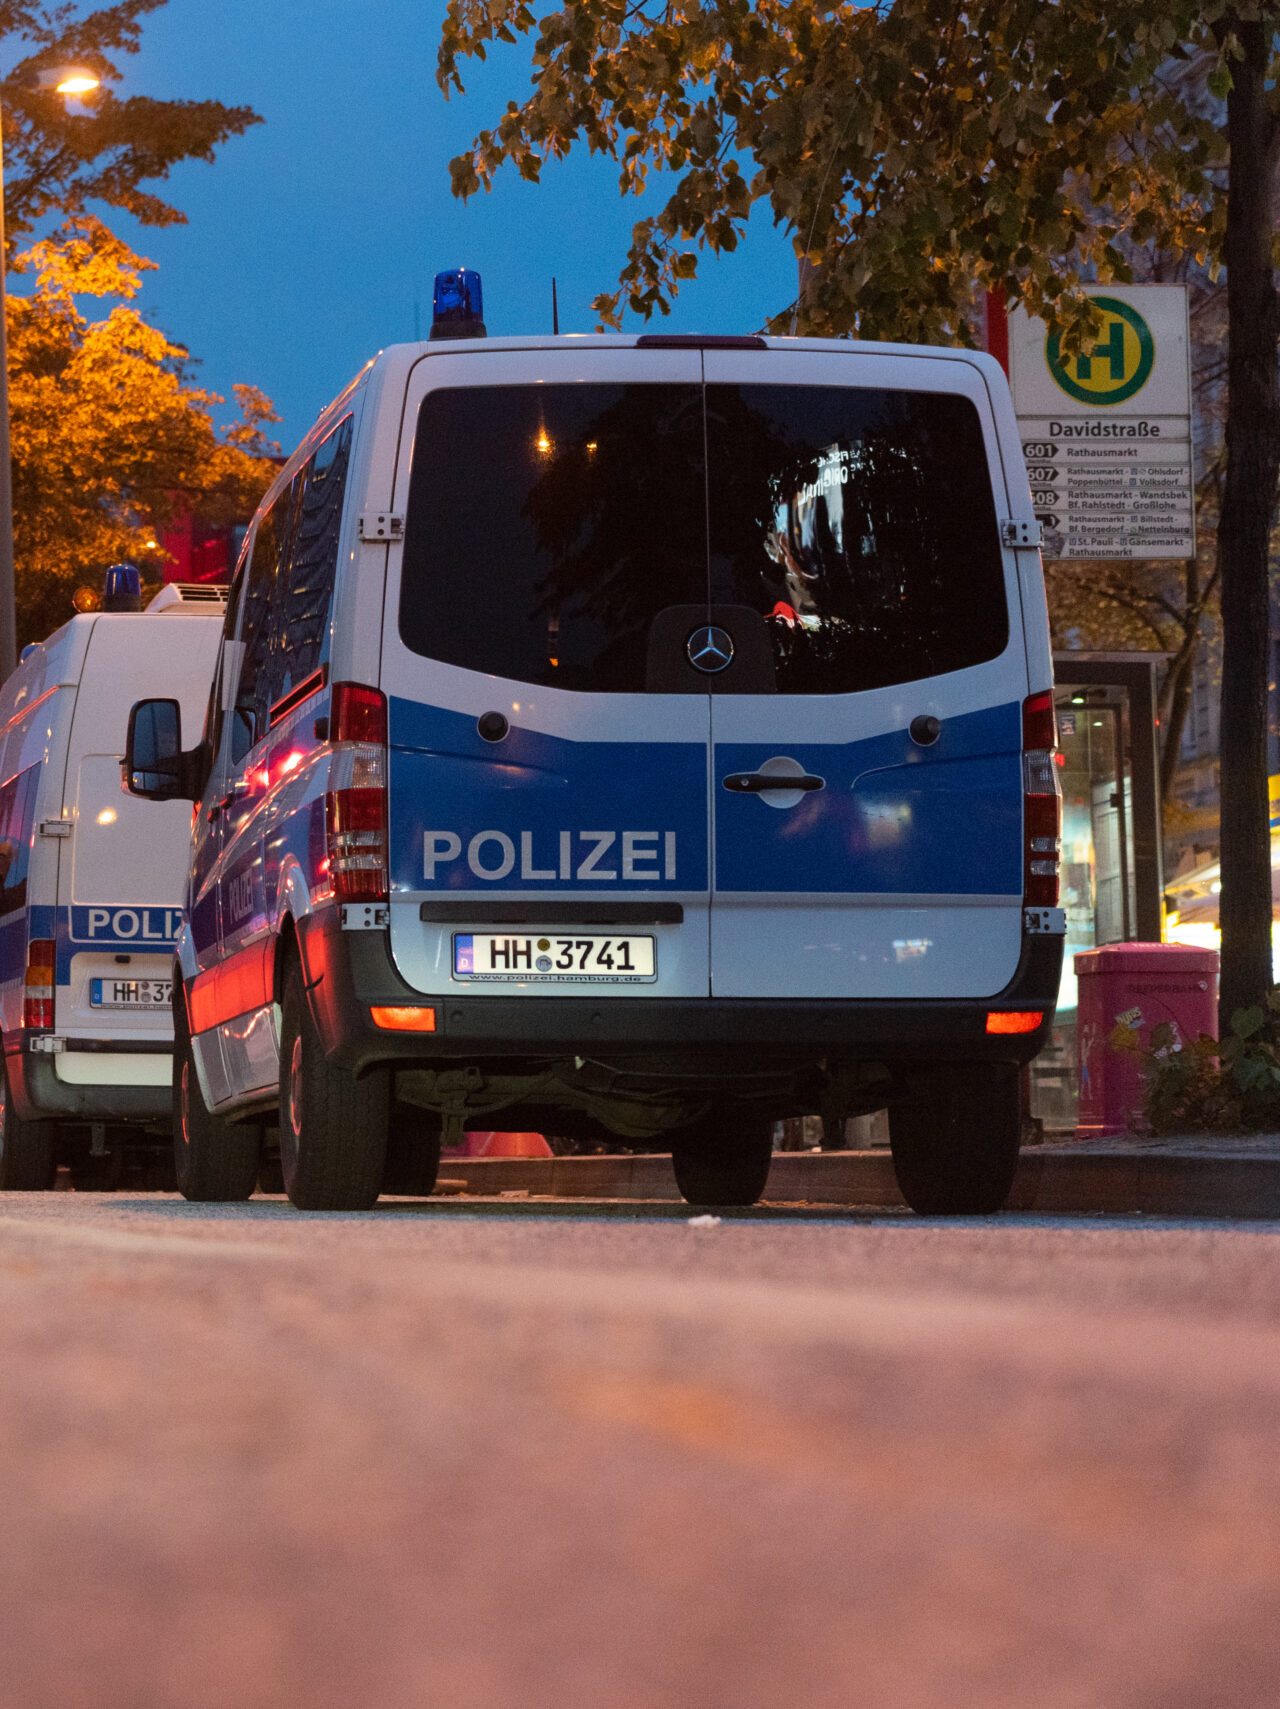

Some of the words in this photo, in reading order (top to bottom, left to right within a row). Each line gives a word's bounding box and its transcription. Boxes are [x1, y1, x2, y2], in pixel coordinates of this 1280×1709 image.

[1049, 421, 1160, 437] Davidstraße
[1025, 444, 1053, 458] 601
[1067, 447, 1138, 457] Rathausmarkt
[1028, 468, 1055, 481] 607
[1147, 468, 1184, 476] Ohlsdorf
[1067, 478, 1123, 487] Poppenbüttel
[1139, 478, 1178, 486] Volksdorf
[1068, 490, 1132, 499] Rathausmarkt
[1139, 490, 1187, 499] Wandsbek
[1068, 501, 1080, 509] Bf.
[1081, 501, 1125, 509] Rahlstedt
[1133, 501, 1176, 509] Großlohe
[1069, 515, 1125, 523] Rathausmarkt
[1140, 515, 1174, 523] Billstedt
[1081, 526, 1124, 534] Bergedorf
[1138, 526, 1190, 535] Nettelnburg
[1078, 538, 1089, 546] St.
[1091, 538, 1114, 546] Pauli
[1069, 548, 1133, 556] Rathausmarkt
[423, 830, 677, 881] POLIZEI
[490, 939, 532, 969] HH
[555, 940, 636, 970] 3741
[469, 974, 642, 982] www.polizei.hamburg.de
[113, 982, 139, 1002] HH
